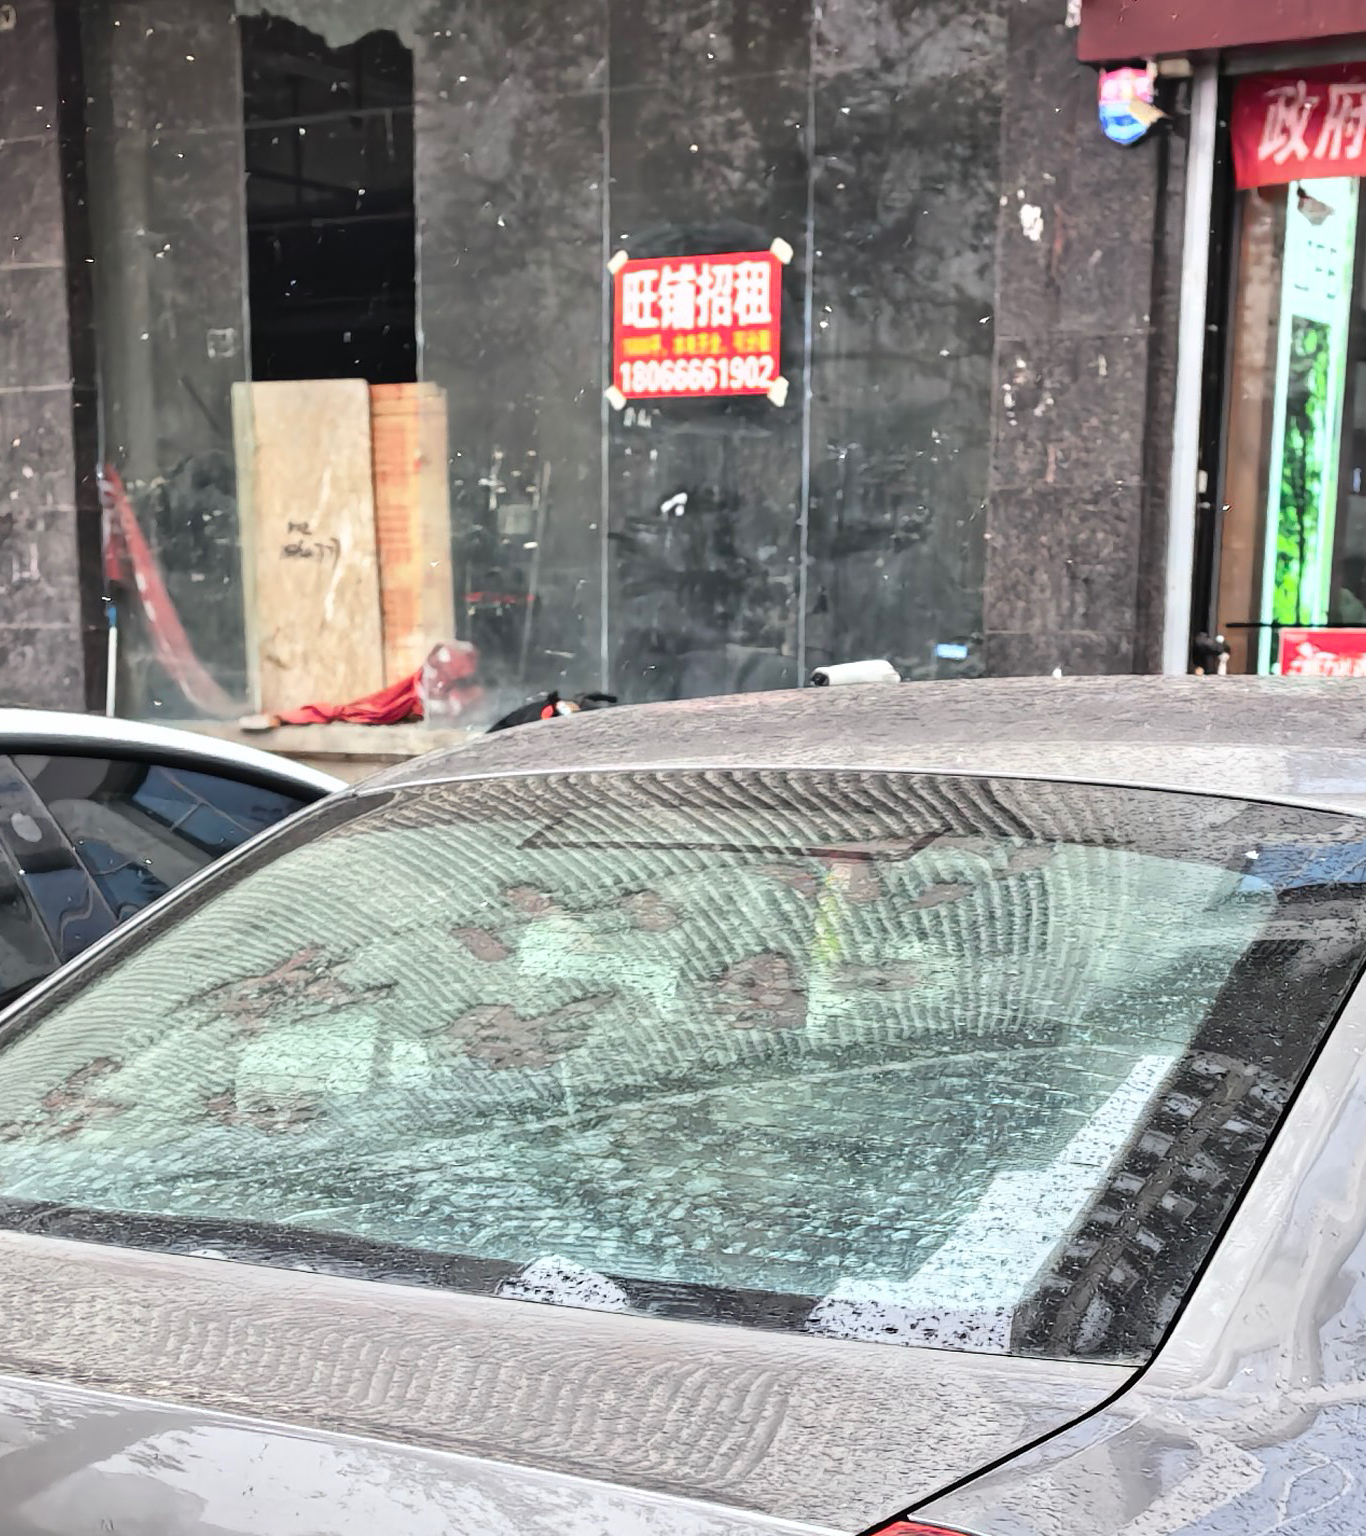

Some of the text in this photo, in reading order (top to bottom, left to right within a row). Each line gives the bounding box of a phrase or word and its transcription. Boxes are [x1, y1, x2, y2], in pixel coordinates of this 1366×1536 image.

[621, 261, 772, 329] 旺铺招租
[619, 355, 775, 393] 18066661902
